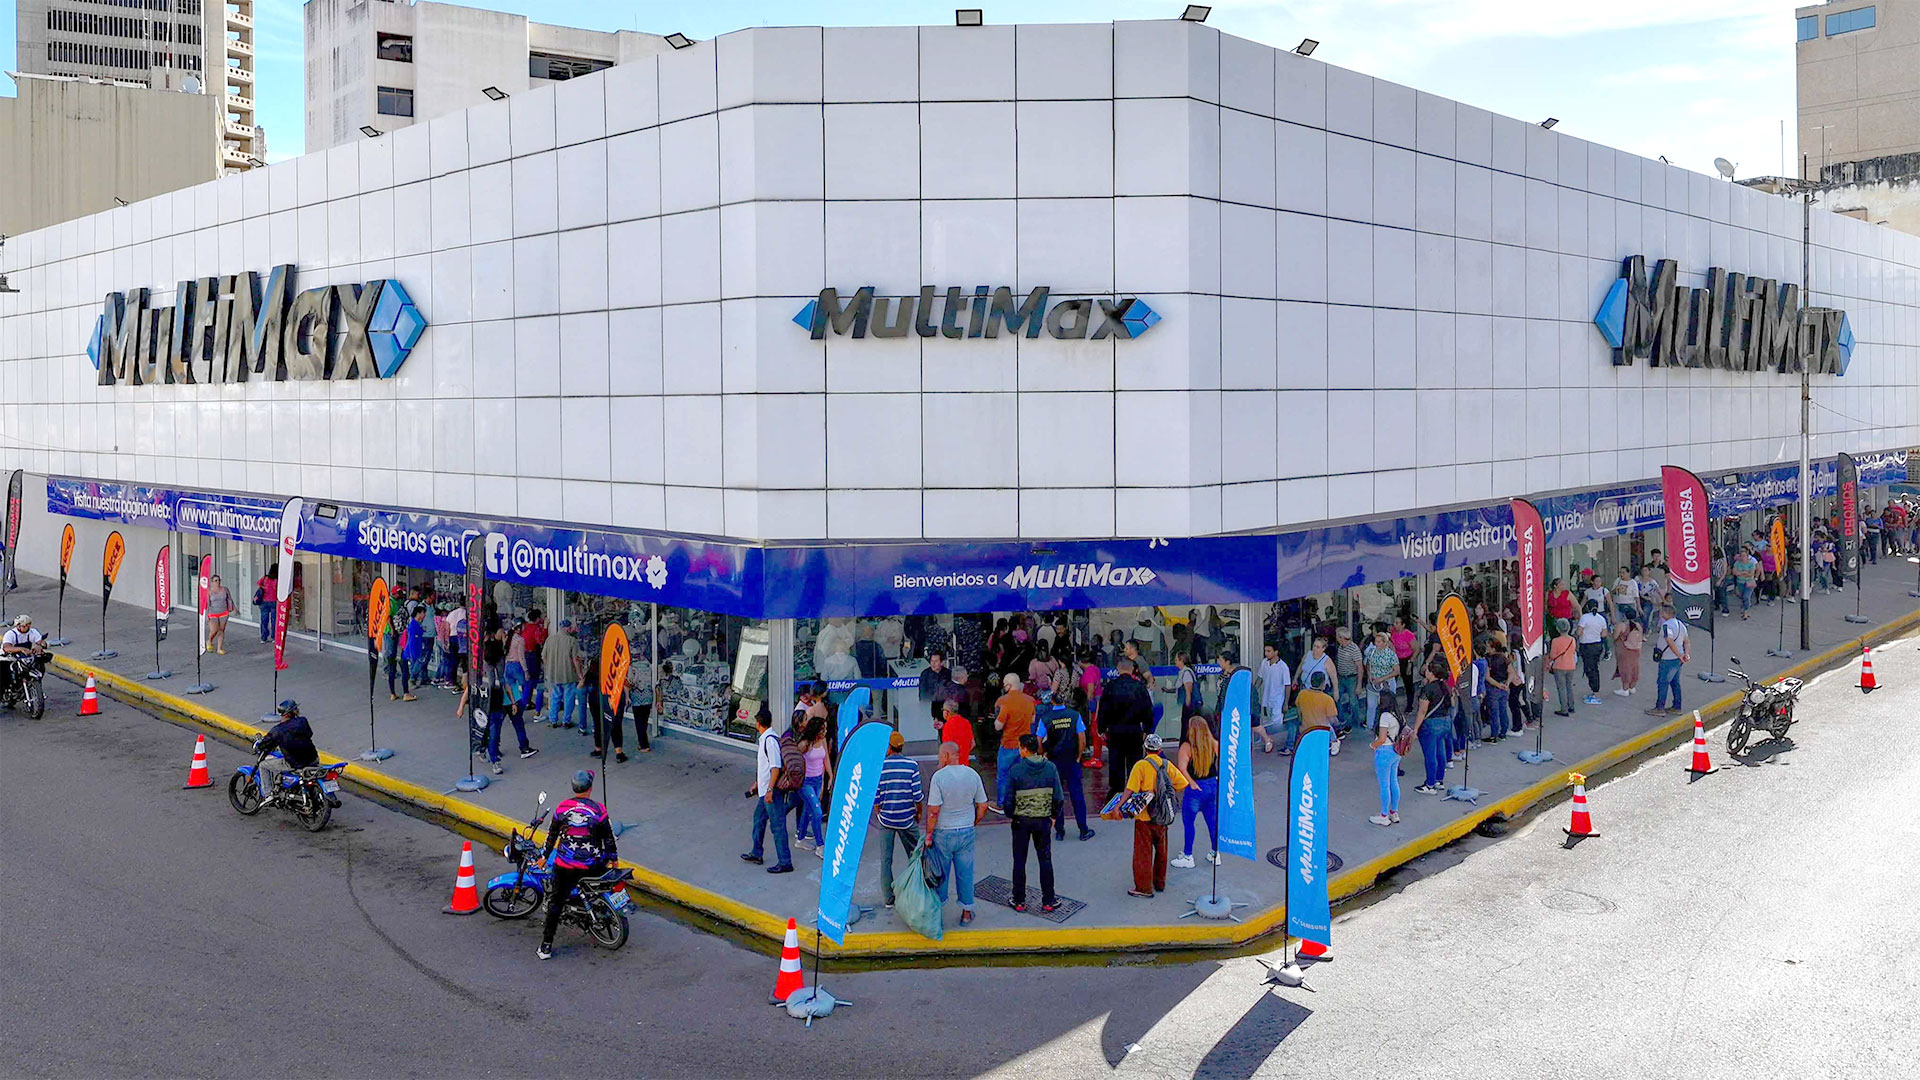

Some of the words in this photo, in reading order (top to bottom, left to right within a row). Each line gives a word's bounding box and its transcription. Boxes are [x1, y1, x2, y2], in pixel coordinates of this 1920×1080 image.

[98, 264, 386, 386] MultiMax
[810, 285, 1137, 340] MultiMax
[1613, 255, 1846, 374] MultiMax
[92, 495, 120, 513] nuestra
[149, 501, 171, 519] web:
[180, 506, 281, 534] www.multimax.com
[1400, 530, 1443, 560] Visita
[1446, 523, 1501, 553] nuestra
[1555, 508, 1585, 533] web:
[1599, 495, 1666, 525] www.multim
[1679, 487, 1698, 572] CONDESA
[358, 520, 428, 555] Síguenos
[511, 538, 643, 583] @multimax
[893, 573, 983, 589] Bienvenidos
[986, 574, 998, 586] a
[1010, 562, 1147, 590] MultiMax
[1523, 525, 1534, 632] CONDESA
[1298, 779, 1318, 881] MultiMax
